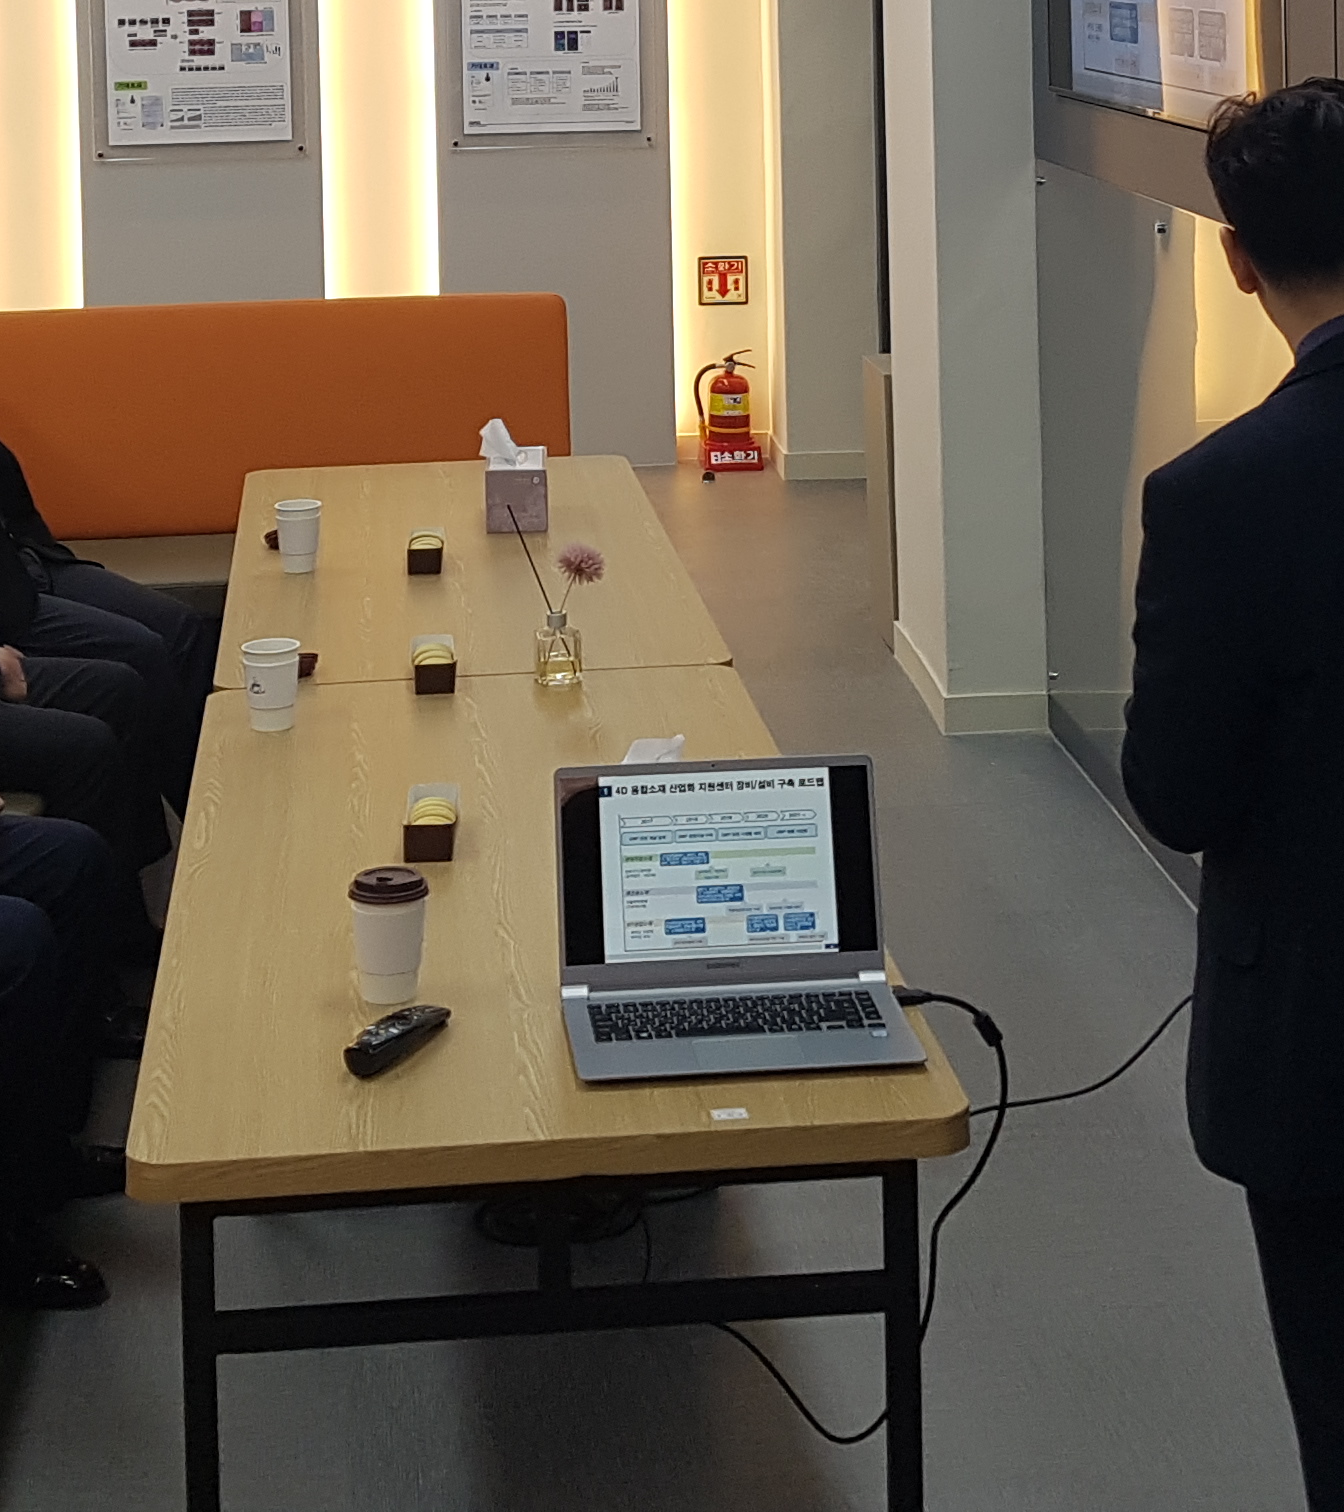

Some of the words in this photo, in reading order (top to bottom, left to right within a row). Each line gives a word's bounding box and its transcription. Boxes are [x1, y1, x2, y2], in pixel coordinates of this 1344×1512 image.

[704, 261, 742, 272] 소화기
[615, 786, 628, 796] 4D
[698, 781, 734, 793] 지원센터
[736, 779, 775, 791] 장비/설비
